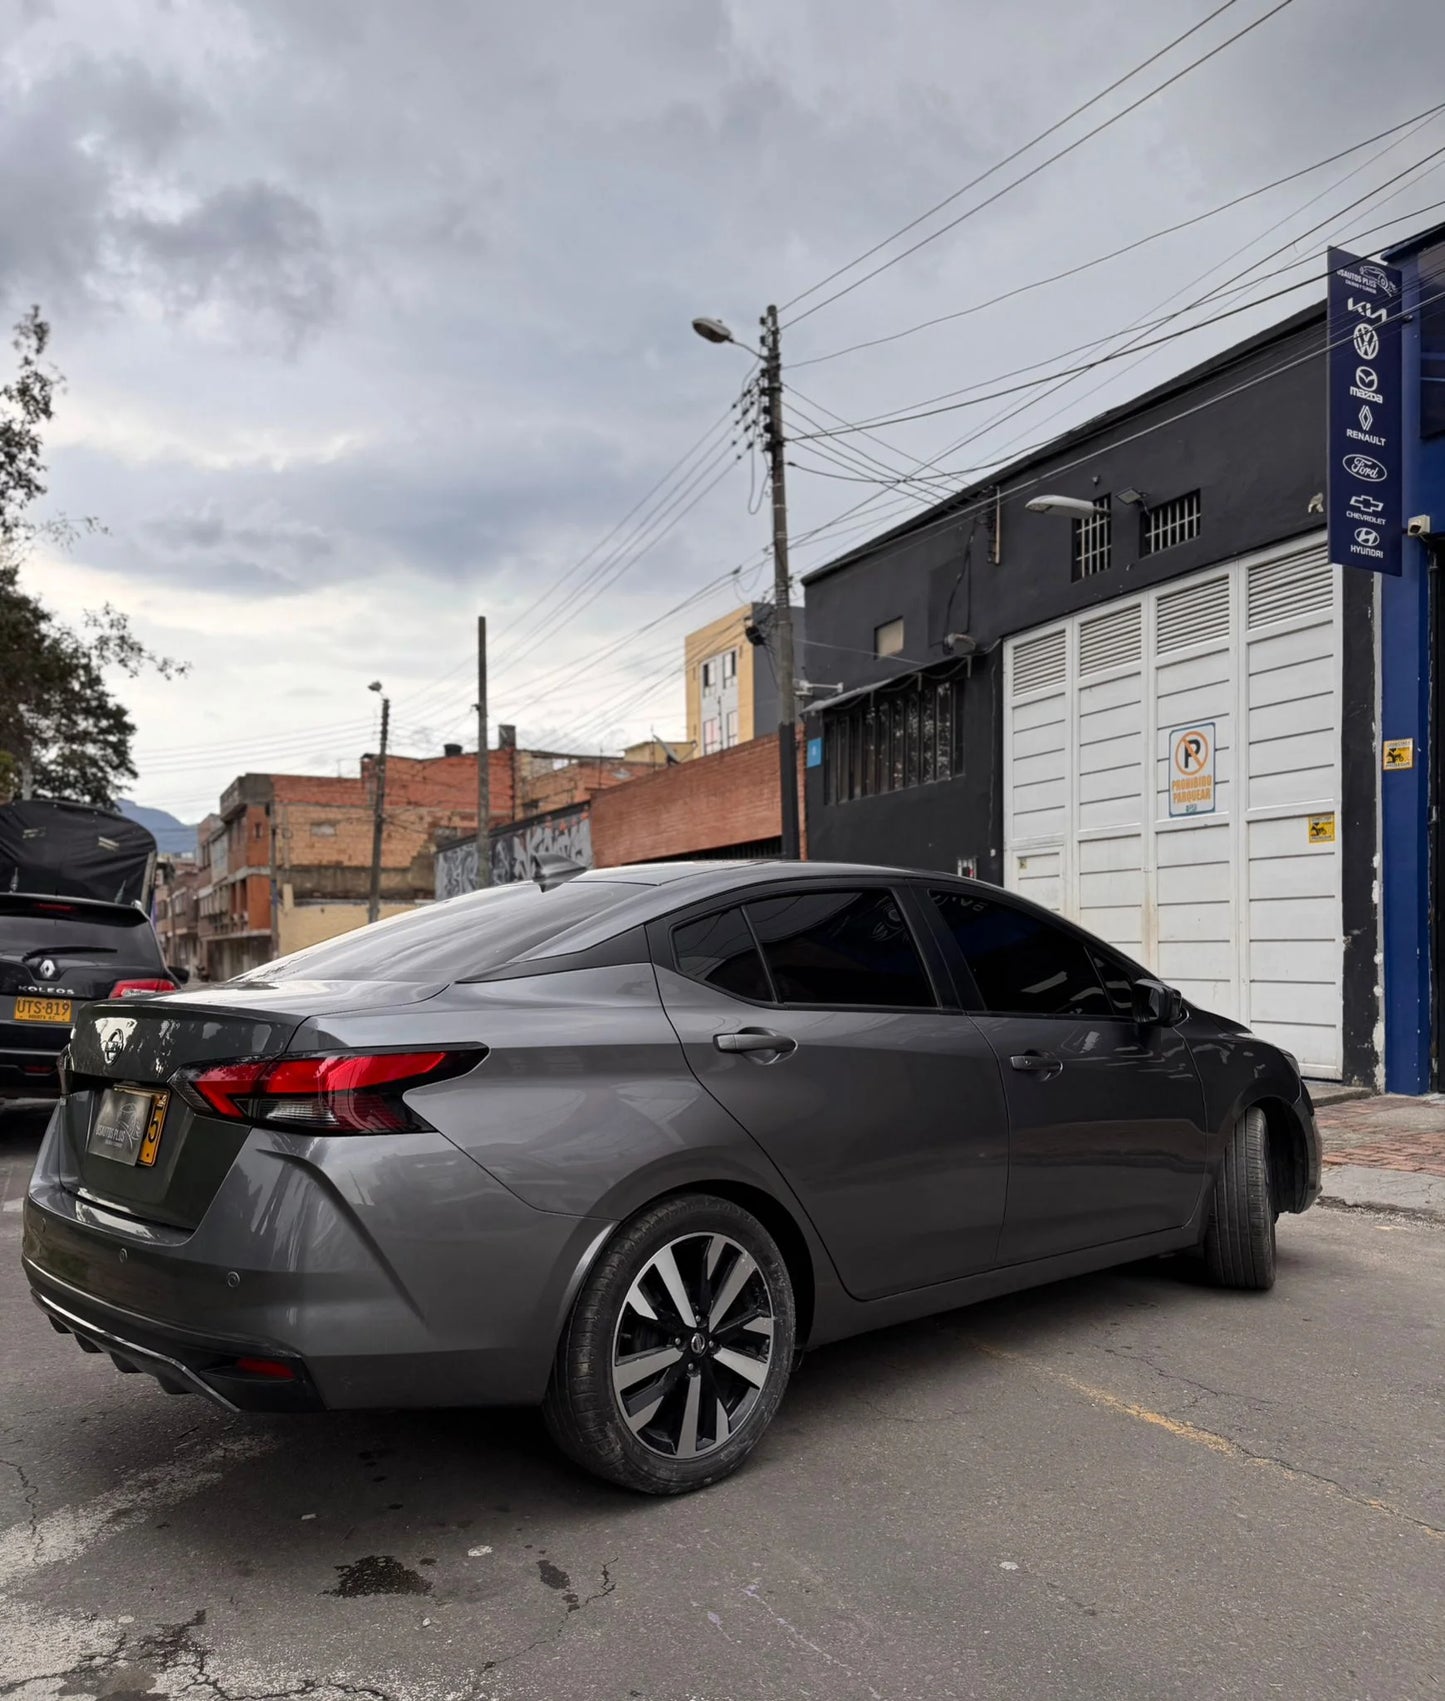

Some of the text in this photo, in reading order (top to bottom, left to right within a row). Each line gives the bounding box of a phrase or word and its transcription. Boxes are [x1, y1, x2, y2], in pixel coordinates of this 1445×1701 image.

[1346, 428, 1386, 446] RENAULT
[1351, 457, 1379, 479] Ford
[1346, 510, 1386, 525] CHEVROLET
[1350, 545, 1383, 558] HYUNDAI
[18, 985, 75, 995] KOLEOS
